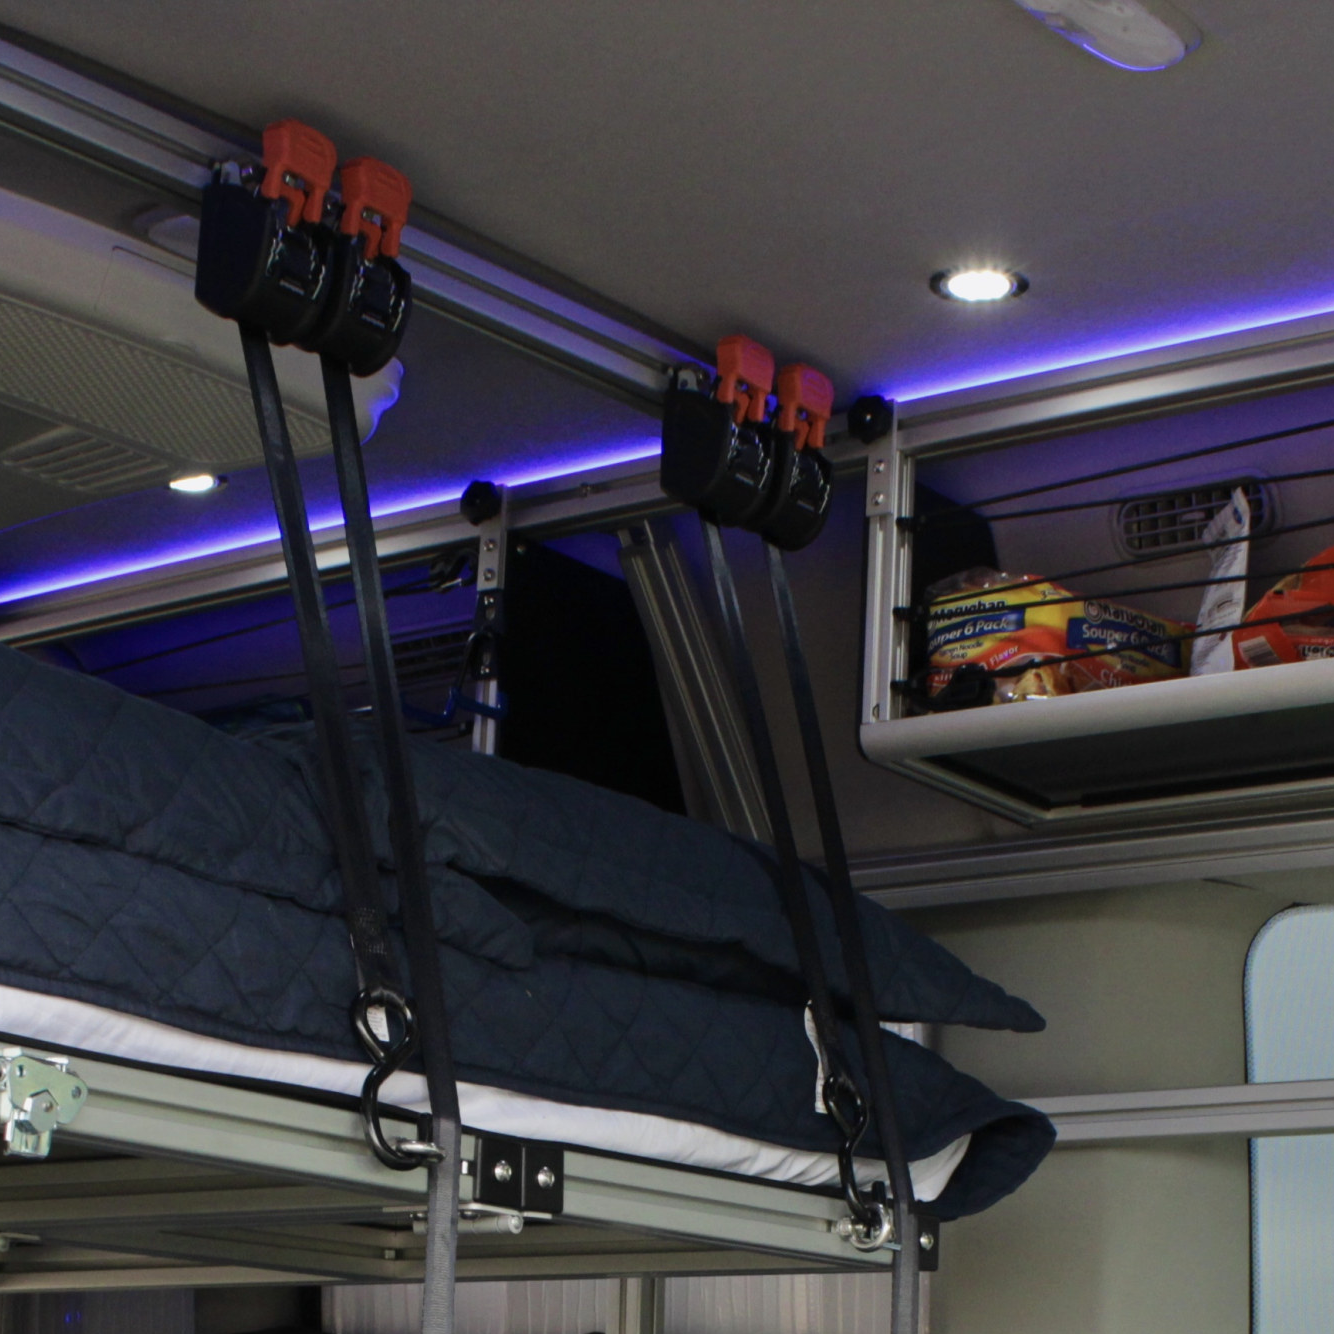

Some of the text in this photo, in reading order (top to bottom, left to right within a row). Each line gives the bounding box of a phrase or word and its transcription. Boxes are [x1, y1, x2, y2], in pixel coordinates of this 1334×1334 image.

[929, 617, 1009, 652] ouper 6 Pack
[1082, 623, 1129, 646] Souper
[1130, 631, 1140, 646] 6
[989, 645, 1020, 667] Flavor
